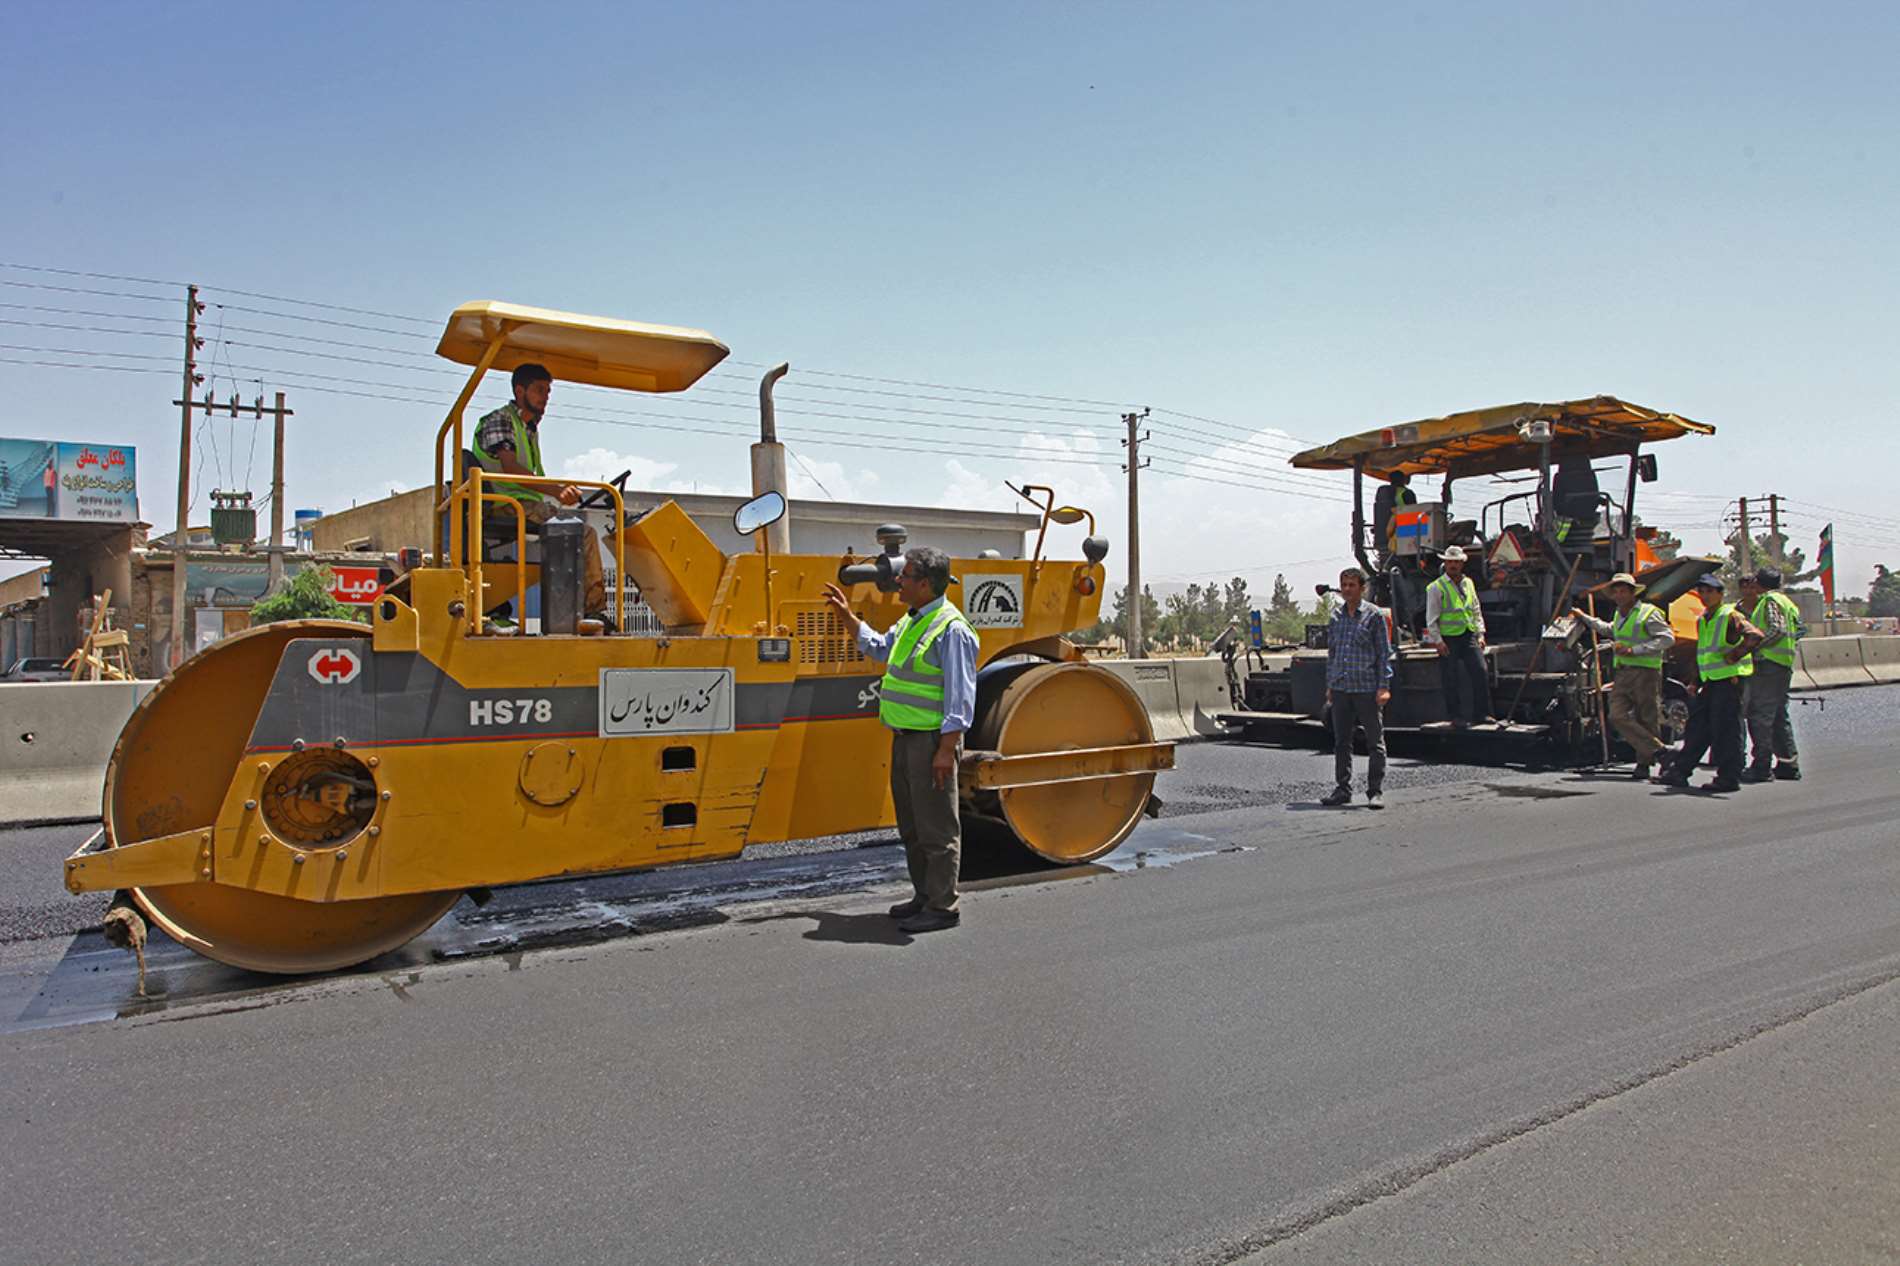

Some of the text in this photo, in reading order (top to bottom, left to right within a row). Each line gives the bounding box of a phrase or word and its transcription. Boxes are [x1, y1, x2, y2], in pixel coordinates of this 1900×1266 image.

[76, 448, 99, 470] معلق
[469, 698, 553, 726] HS78
[610, 673, 725, 730] کندوان پارس
